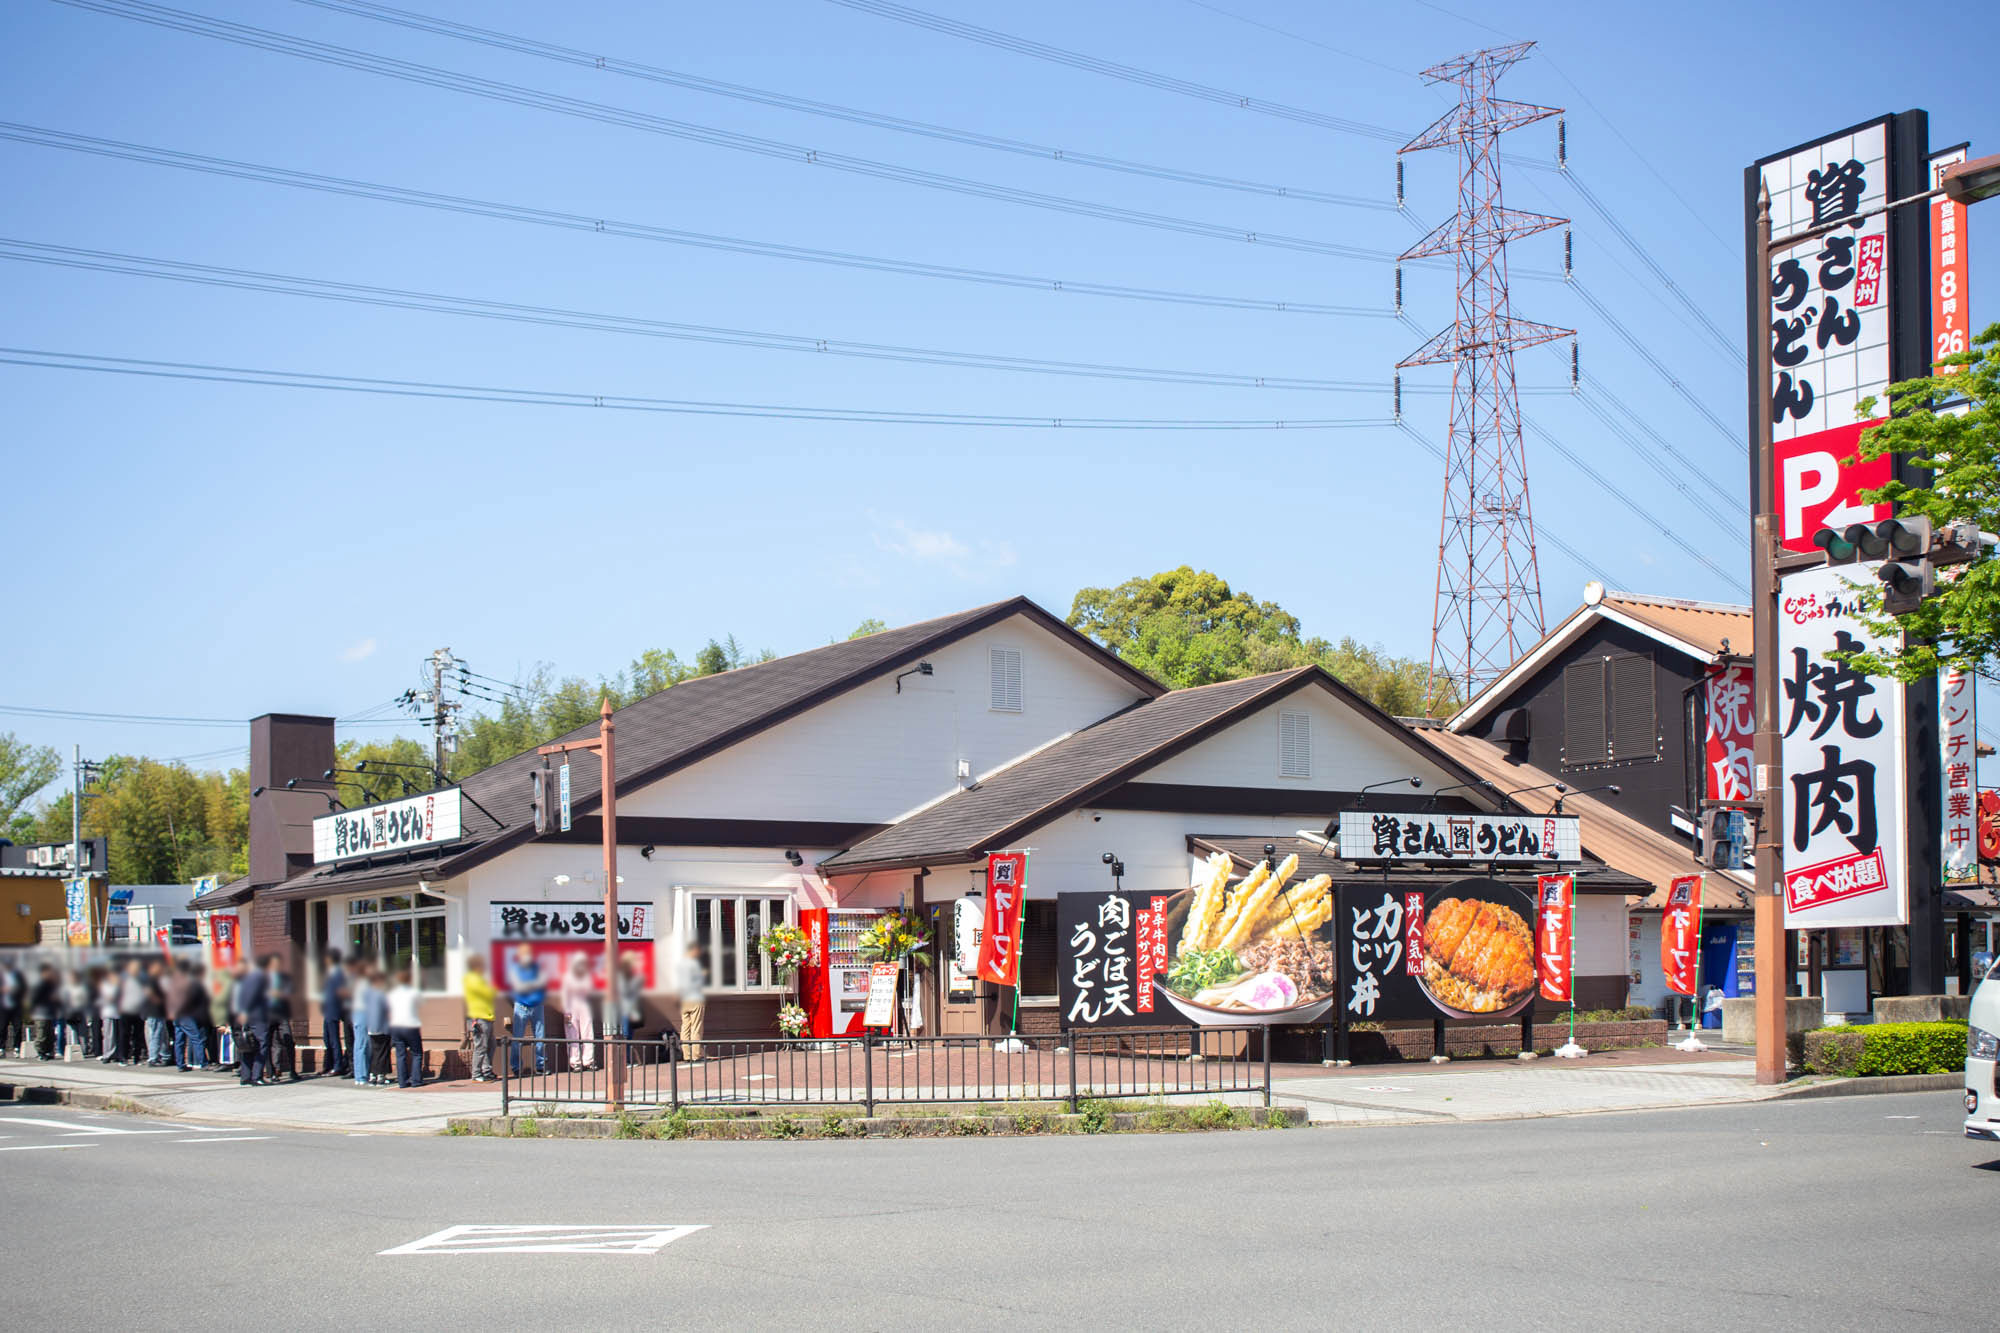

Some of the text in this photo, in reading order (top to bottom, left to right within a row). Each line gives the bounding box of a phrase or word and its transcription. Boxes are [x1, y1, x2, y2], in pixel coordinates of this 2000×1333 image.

[1805, 158, 1867, 350] 資さん
[1856, 238, 1882, 304] 北九州
[1771, 258, 1818, 424] うどん
[1783, 451, 1839, 541] P
[1704, 666, 1755, 802] 焼肉
[1783, 630, 1883, 857] 焼肉
[1947, 673, 1972, 850] ランチ営業中
[335, 816, 371, 856] 資さん
[388, 806, 423, 844] うどん
[1372, 814, 1540, 857] 資さん 資 うどん
[1790, 857, 1882, 905] 食べ放題
[1067, 922, 1101, 1023] うどん
[1098, 895, 1135, 1016] 肉ごぼ天
[1152, 899, 1166, 969] 甘辛牛肉と
[1348, 906, 1381, 1017] とじ丼
[1371, 893, 1404, 976] カツ
